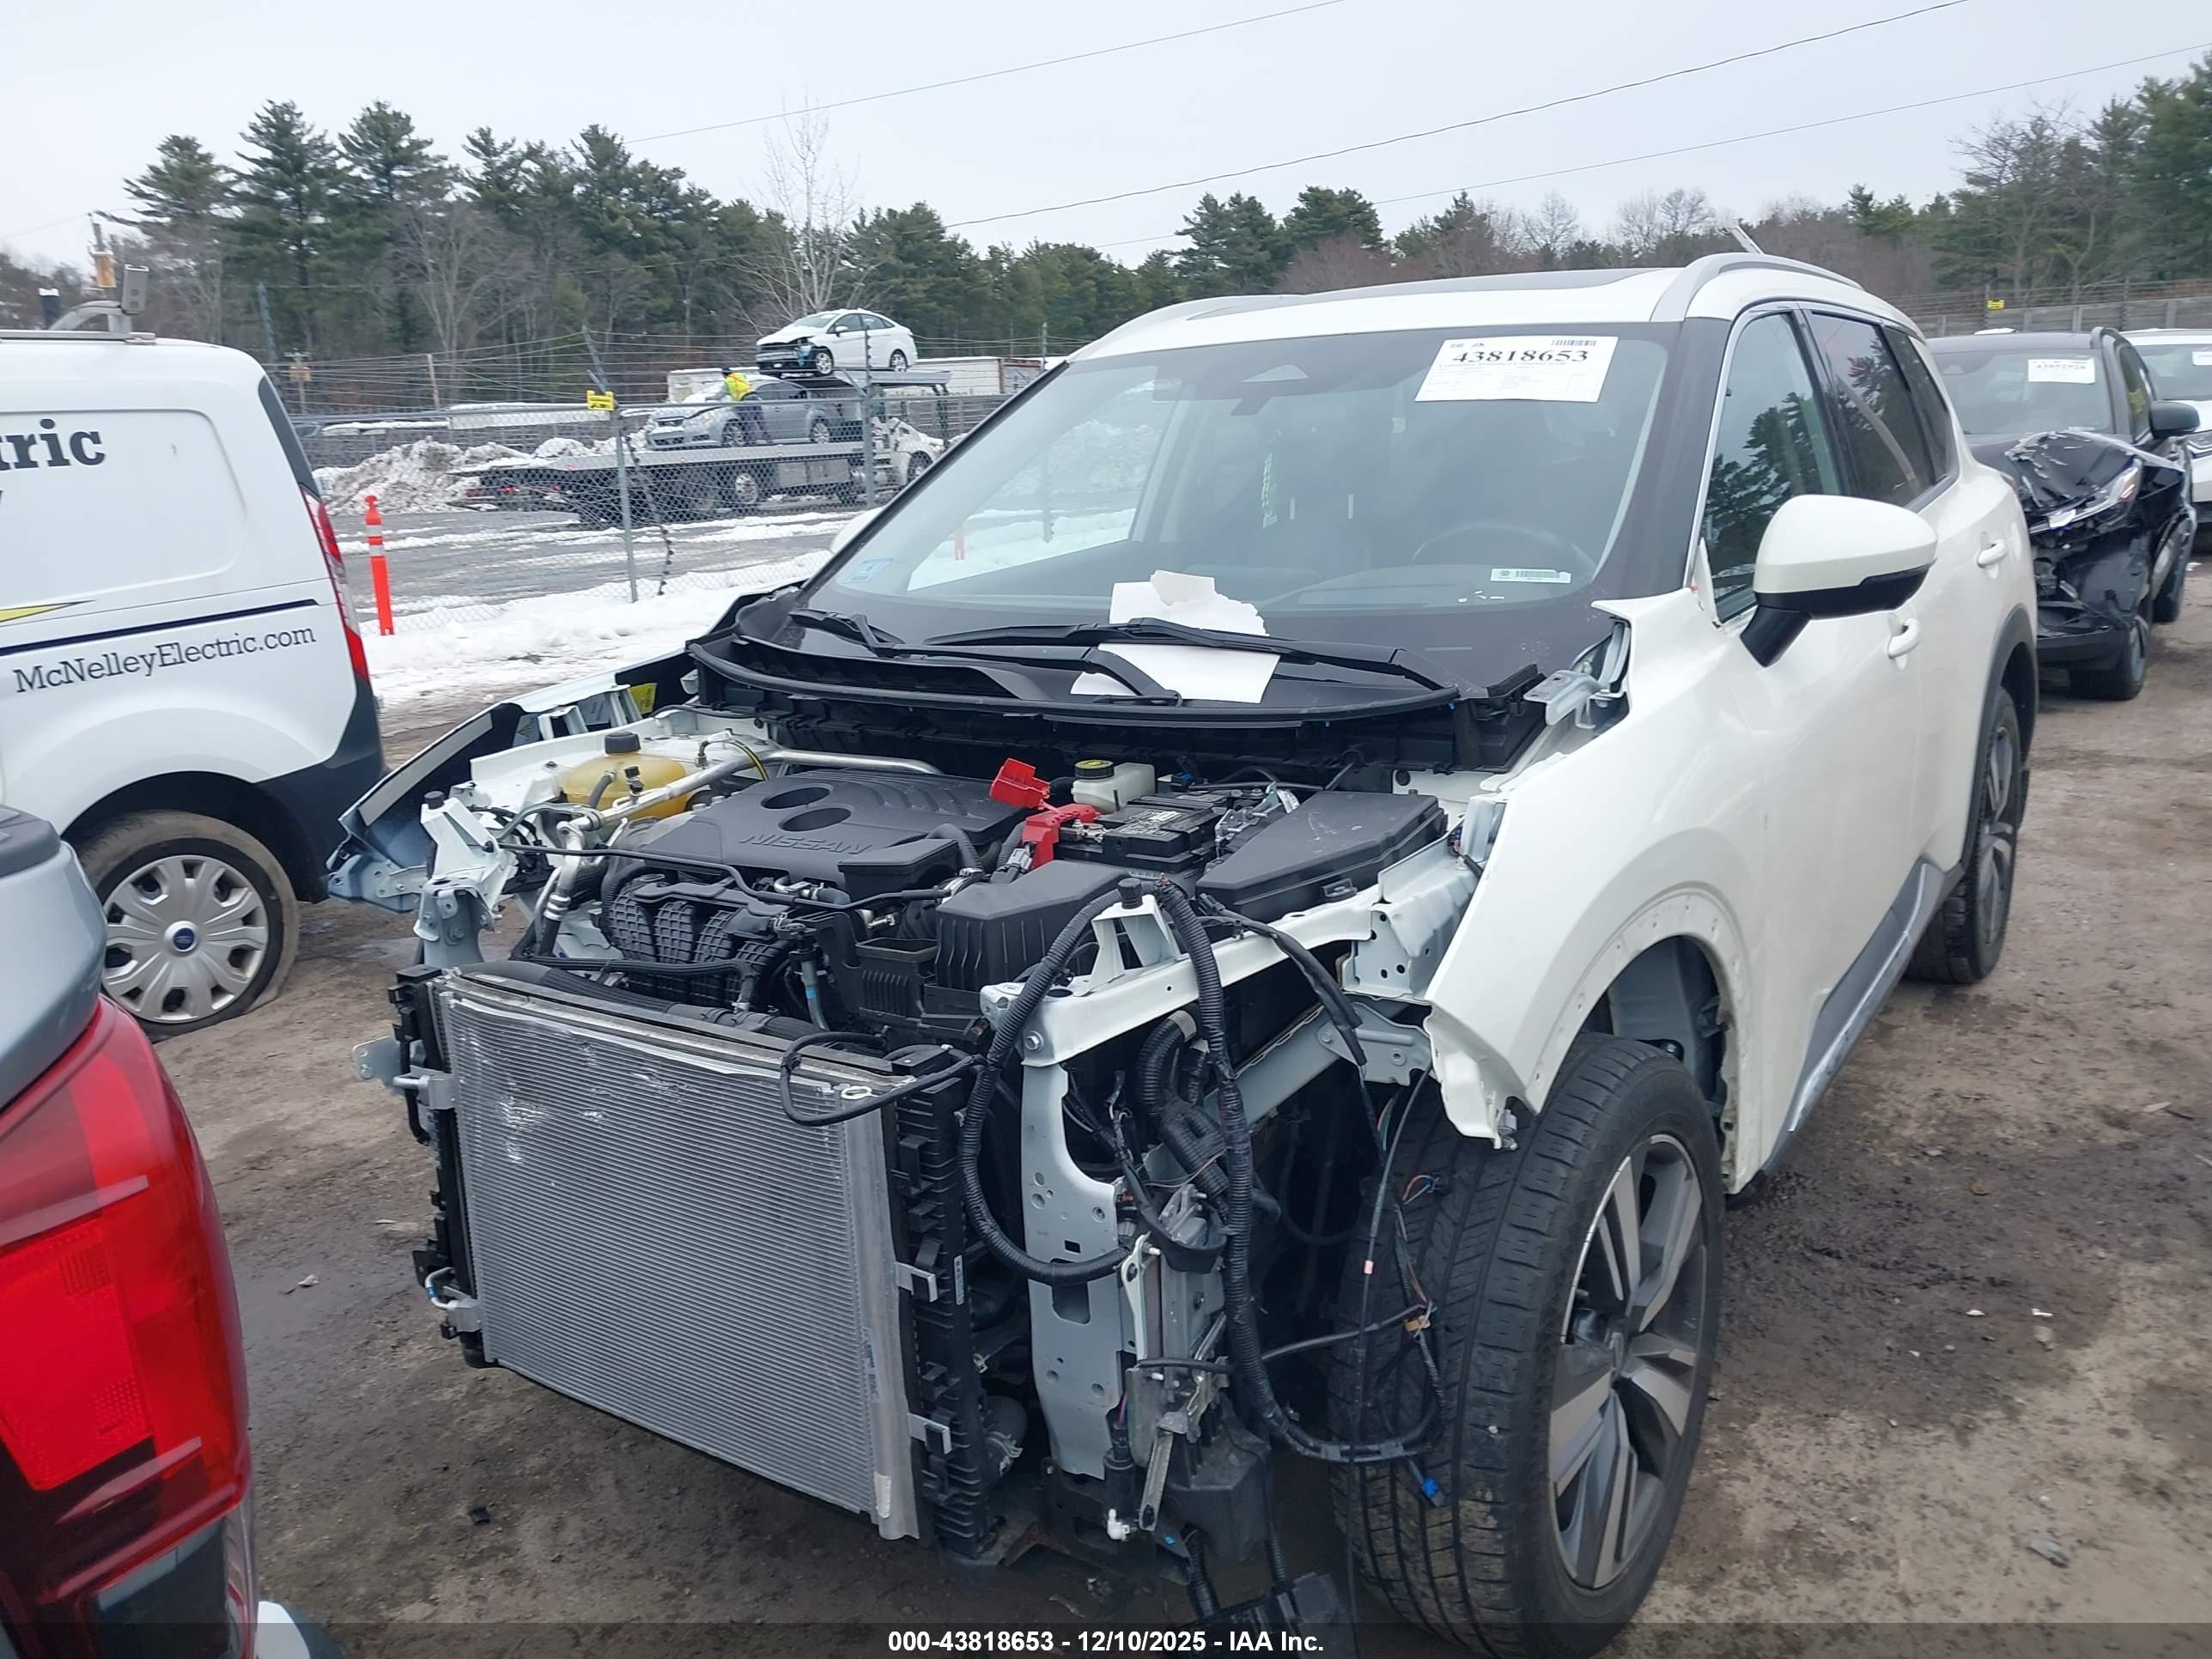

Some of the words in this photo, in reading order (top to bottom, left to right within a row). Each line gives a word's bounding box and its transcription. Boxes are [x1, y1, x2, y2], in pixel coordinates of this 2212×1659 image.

[1452, 349, 1589, 363] 43818653
[13, 626, 316, 693] McNelleyElectric.com
[738, 833, 873, 855] NISSAN
